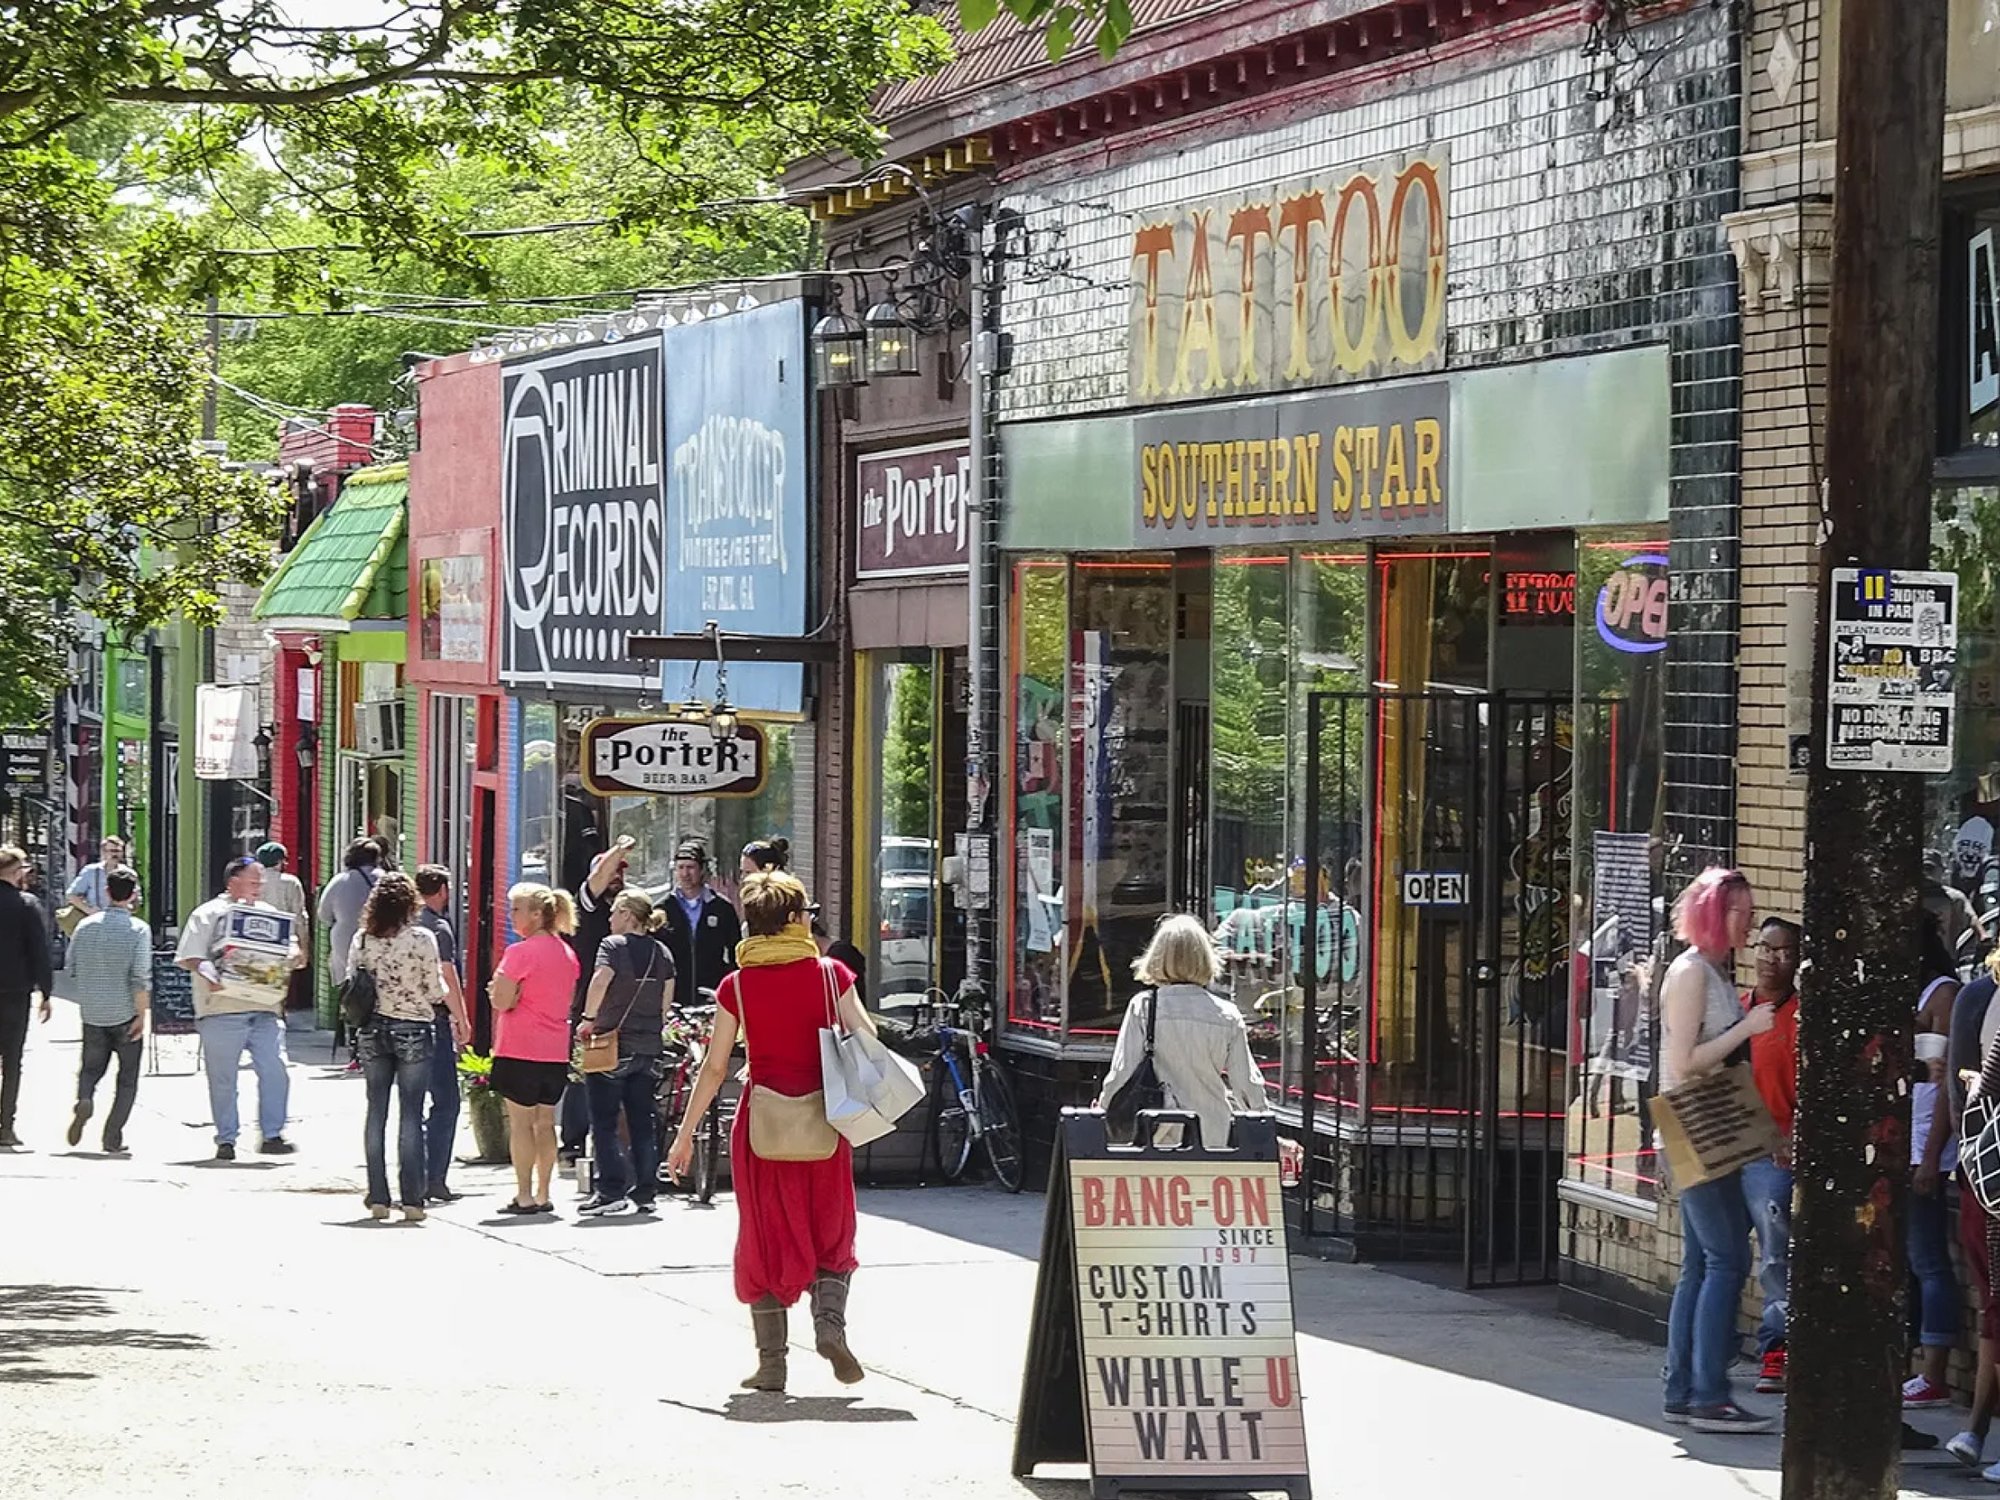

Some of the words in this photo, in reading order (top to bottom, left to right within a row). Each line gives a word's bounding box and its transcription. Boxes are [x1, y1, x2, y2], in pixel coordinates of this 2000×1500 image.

[1133, 160, 1443, 397] TATTOO
[1141, 432, 1320, 528] SOUTHERN
[1332, 418, 1442, 522] STAR
[863, 487, 883, 528] the
[1603, 571, 1668, 639] OPE
[1889, 588, 1935, 602] ENDING
[1886, 605, 1913, 618] PAR
[1836, 625, 1879, 635] ATLANTA
[1841, 709, 1860, 723] NO
[660, 727, 688, 742] the
[643, 774, 676, 785] BEER
[680, 774, 708, 785] BAR
[1409, 877, 1464, 900] OPEN
[1082, 1175, 1270, 1227] BANG-ON
[1219, 1229, 1274, 1246] SINCE
[1201, 1247, 1257, 1263] 1997
[1088, 1265, 1223, 1300] CUSTOM
[1097, 1357, 1244, 1406] WHILE
[1266, 1357, 1292, 1408] U
[1133, 1411, 1262, 1460] WAIT
